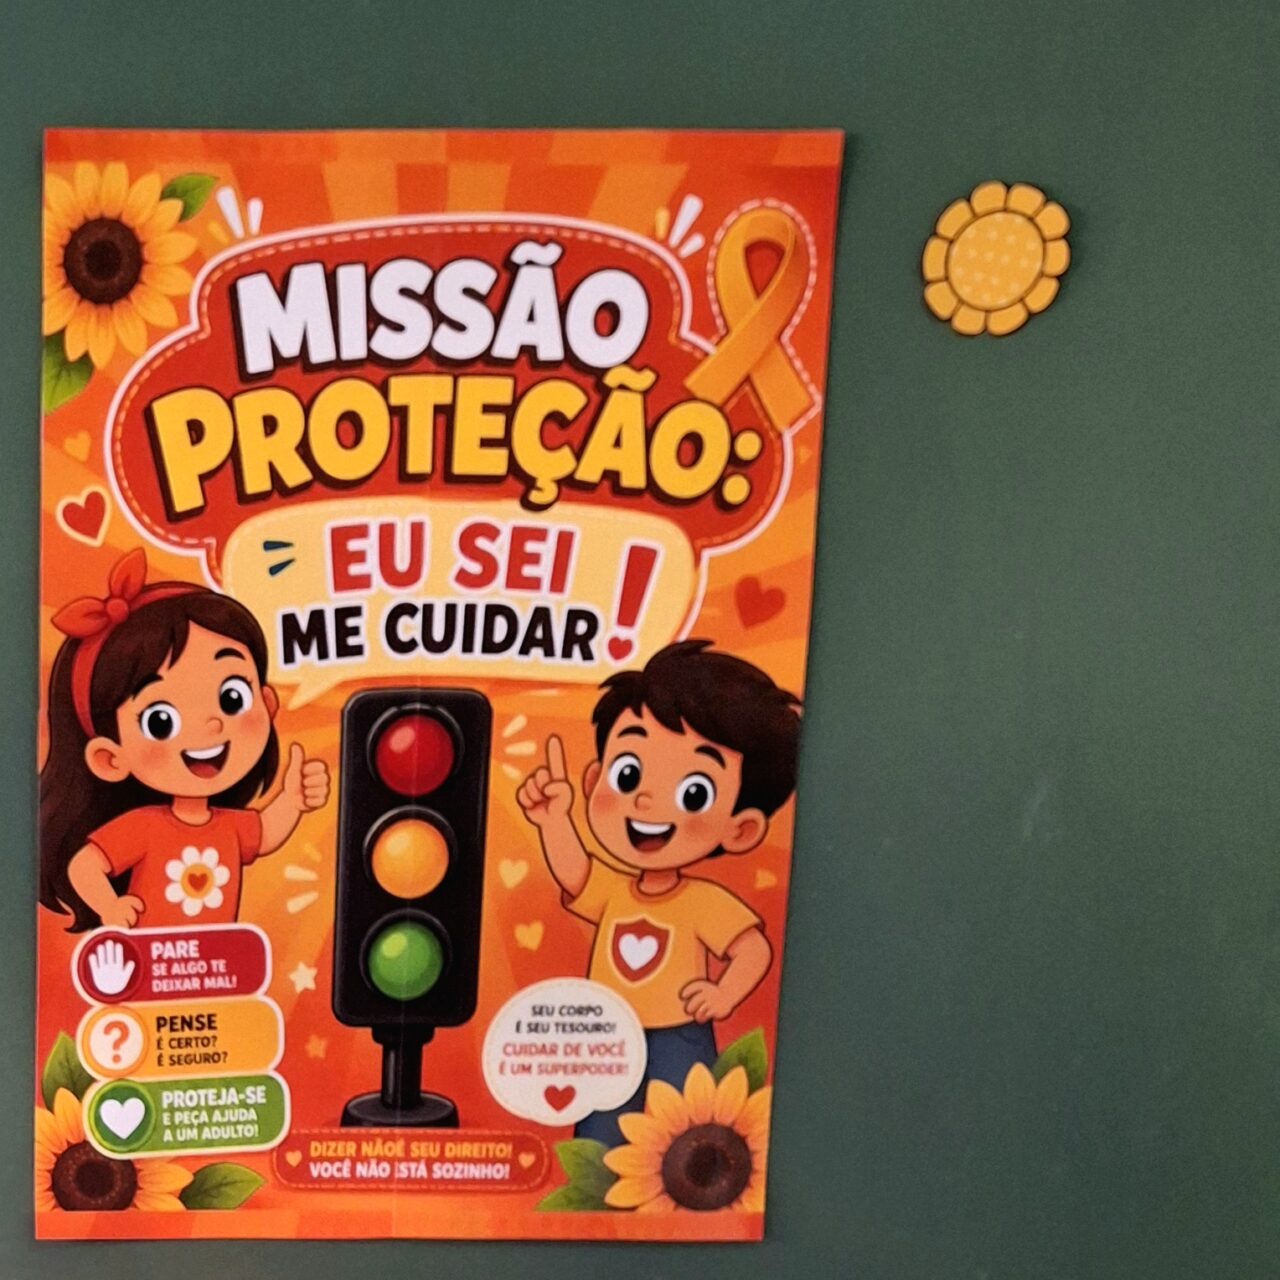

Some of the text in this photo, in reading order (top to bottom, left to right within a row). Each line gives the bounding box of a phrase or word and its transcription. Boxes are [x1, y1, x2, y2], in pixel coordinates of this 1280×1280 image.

[236, 241, 649, 376] MISSÃO
[148, 368, 763, 521] PROTEÇÃO:
[329, 520, 571, 596] EU SEI
[280, 606, 364, 664] ME
[151, 940, 199, 960] PARE
[152, 959, 226, 976] SE ALGO TE
[152, 975, 236, 992] DEIXAR MAL!
[531, 1004, 603, 1016] SEU CORPO
[156, 1014, 218, 1032] PENSE
[527, 1022, 550, 1033] SEU
[554, 1022, 617, 1034] TESOURO!
[157, 1036, 218, 1049] É CERTO?
[502, 1040, 626, 1057] CUIDAR DE VOCÊ
[157, 1051, 229, 1067] É SEGURO?
[511, 1063, 532, 1075] UM
[537, 1063, 629, 1076] SUPERPODER!
[162, 1086, 266, 1108] PROTEJA-SE
[163, 1108, 257, 1127] E PEÇA AJUDA
[163, 1125, 259, 1142] A UM ADULTO!
[310, 1141, 356, 1158] DIZER
[410, 1141, 441, 1158] SEU
[445, 1142, 513, 1158] DIREITO!
[310, 1158, 351, 1178] VOCÊ
[356, 1158, 390, 1178] NÃO
[432, 1161, 510, 1179] SOZINHO!
